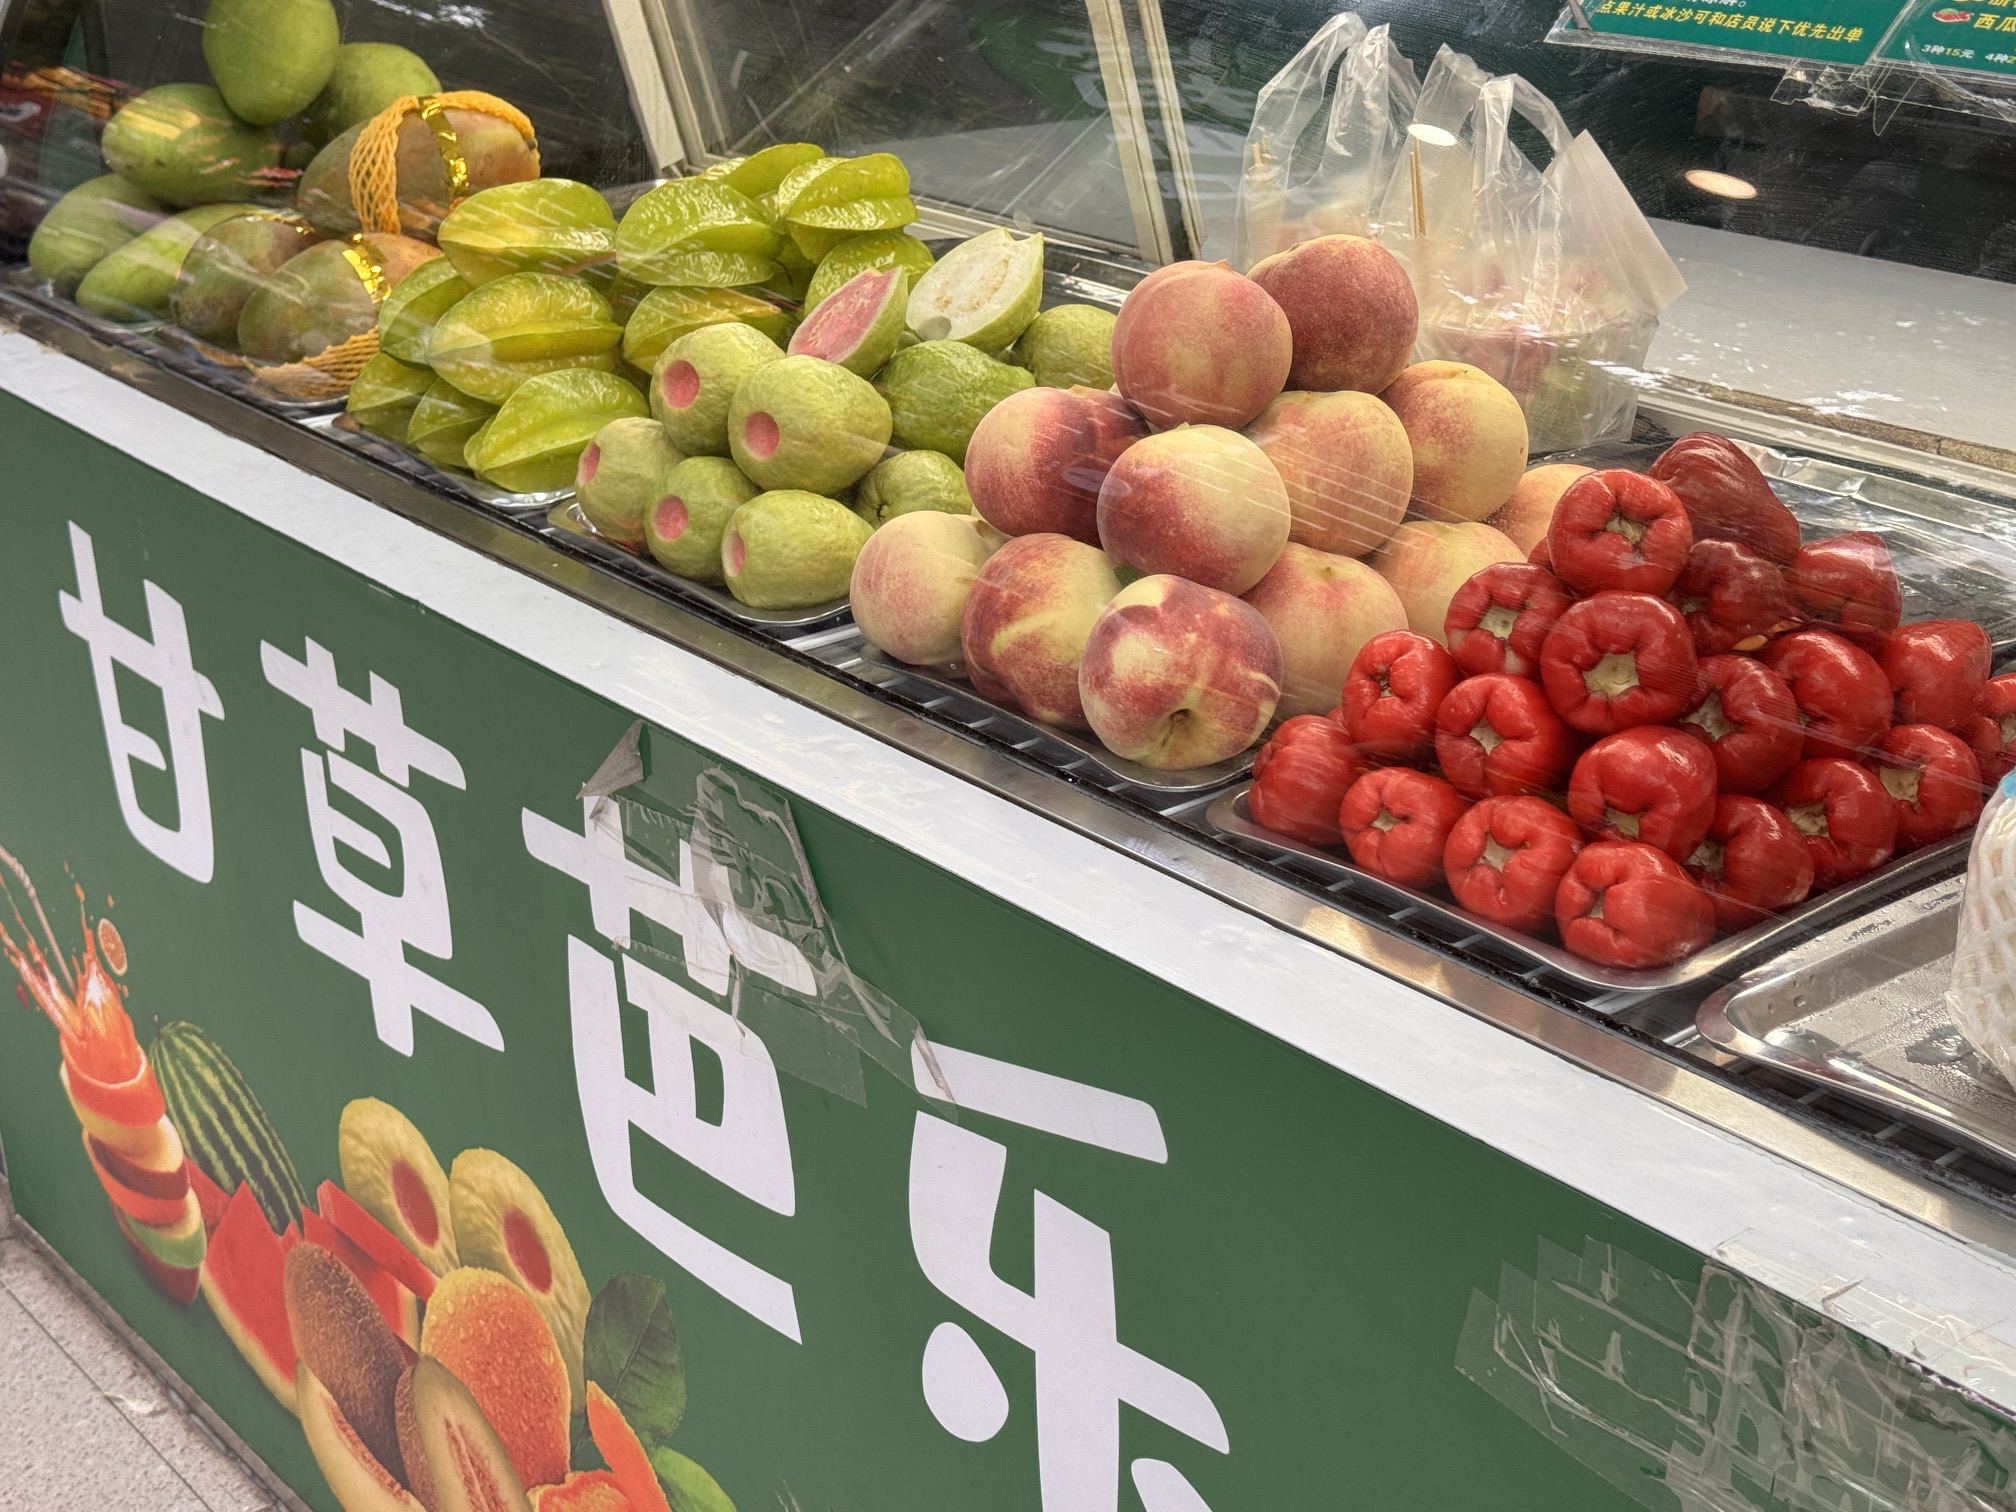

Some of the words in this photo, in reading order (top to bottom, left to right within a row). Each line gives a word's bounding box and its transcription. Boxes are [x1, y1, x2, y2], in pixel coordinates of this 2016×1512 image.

[1598, 0, 1864, 43] 点果汁或冰沙可和店员说下优先出单
[1921, 44, 1975, 59] 3种15元
